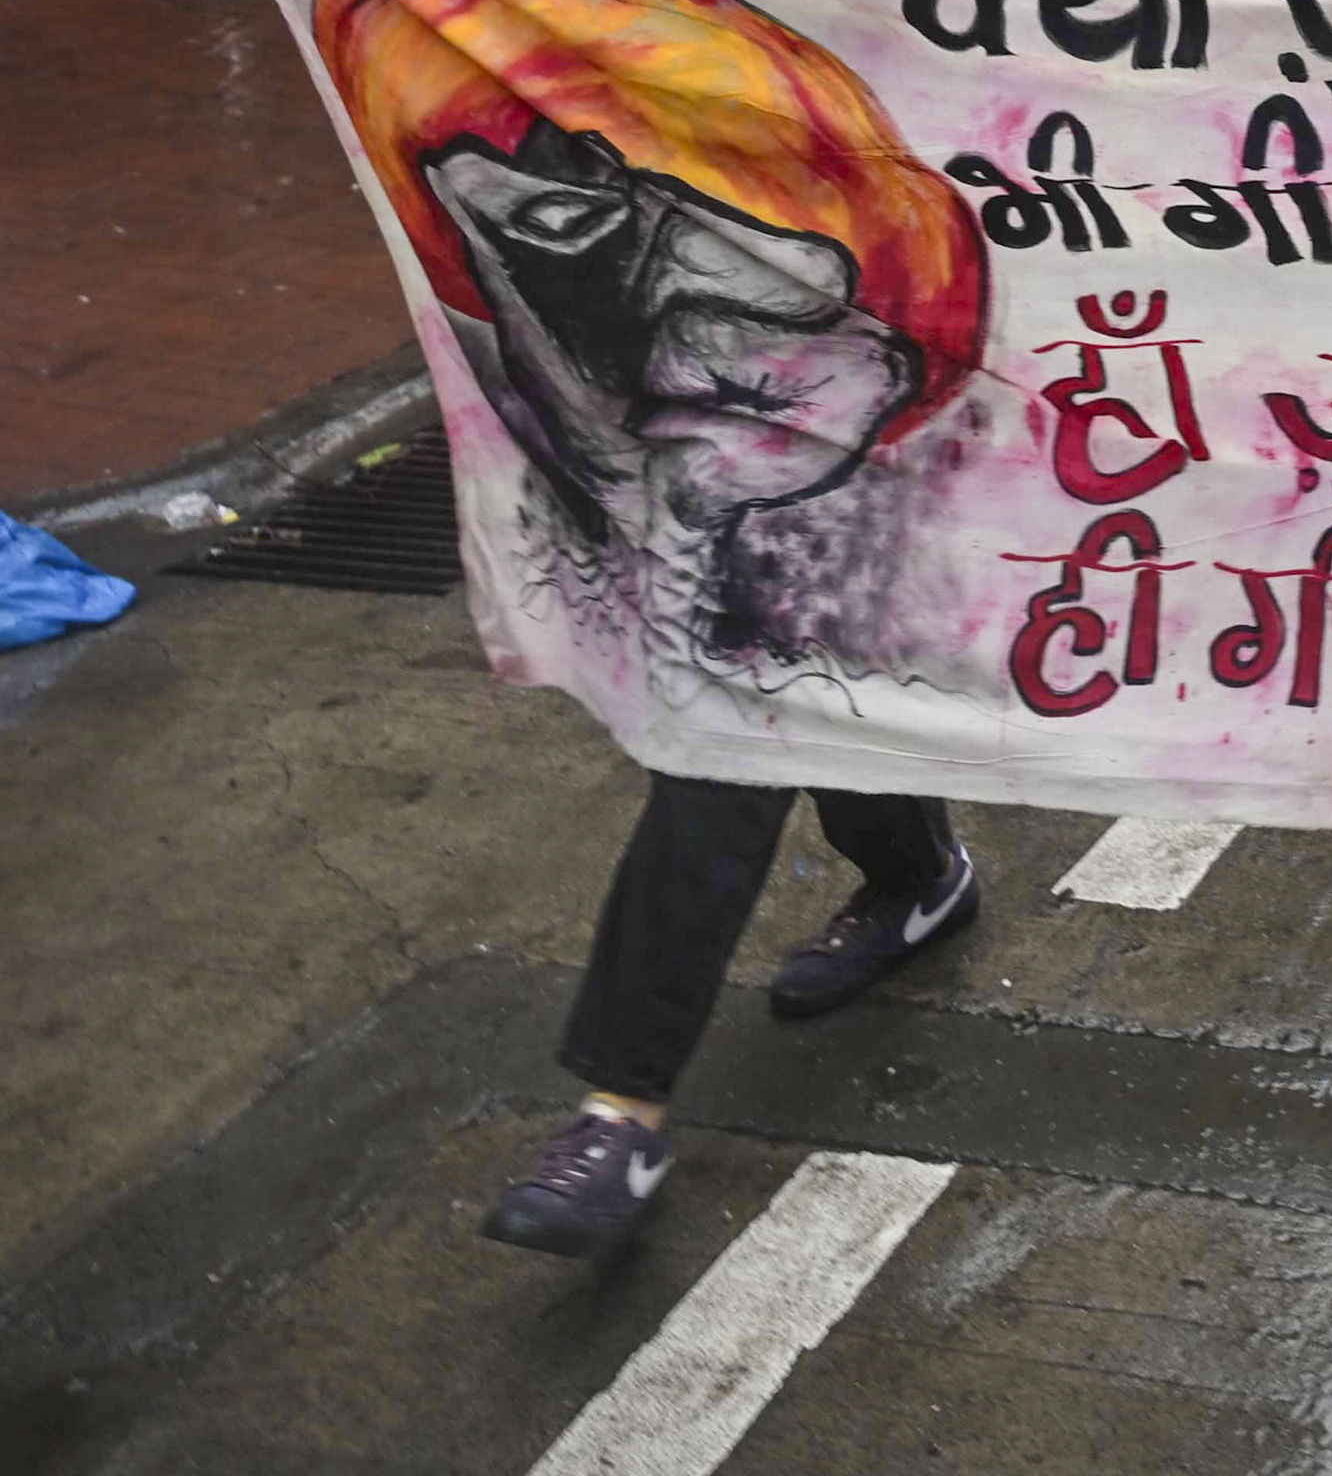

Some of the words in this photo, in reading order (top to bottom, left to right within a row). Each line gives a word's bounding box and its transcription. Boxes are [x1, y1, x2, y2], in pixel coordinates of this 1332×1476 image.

[945, 110, 1145, 251] भी
[1033, 288, 1210, 506] हाँ
[1000, 508, 1196, 718] ही
